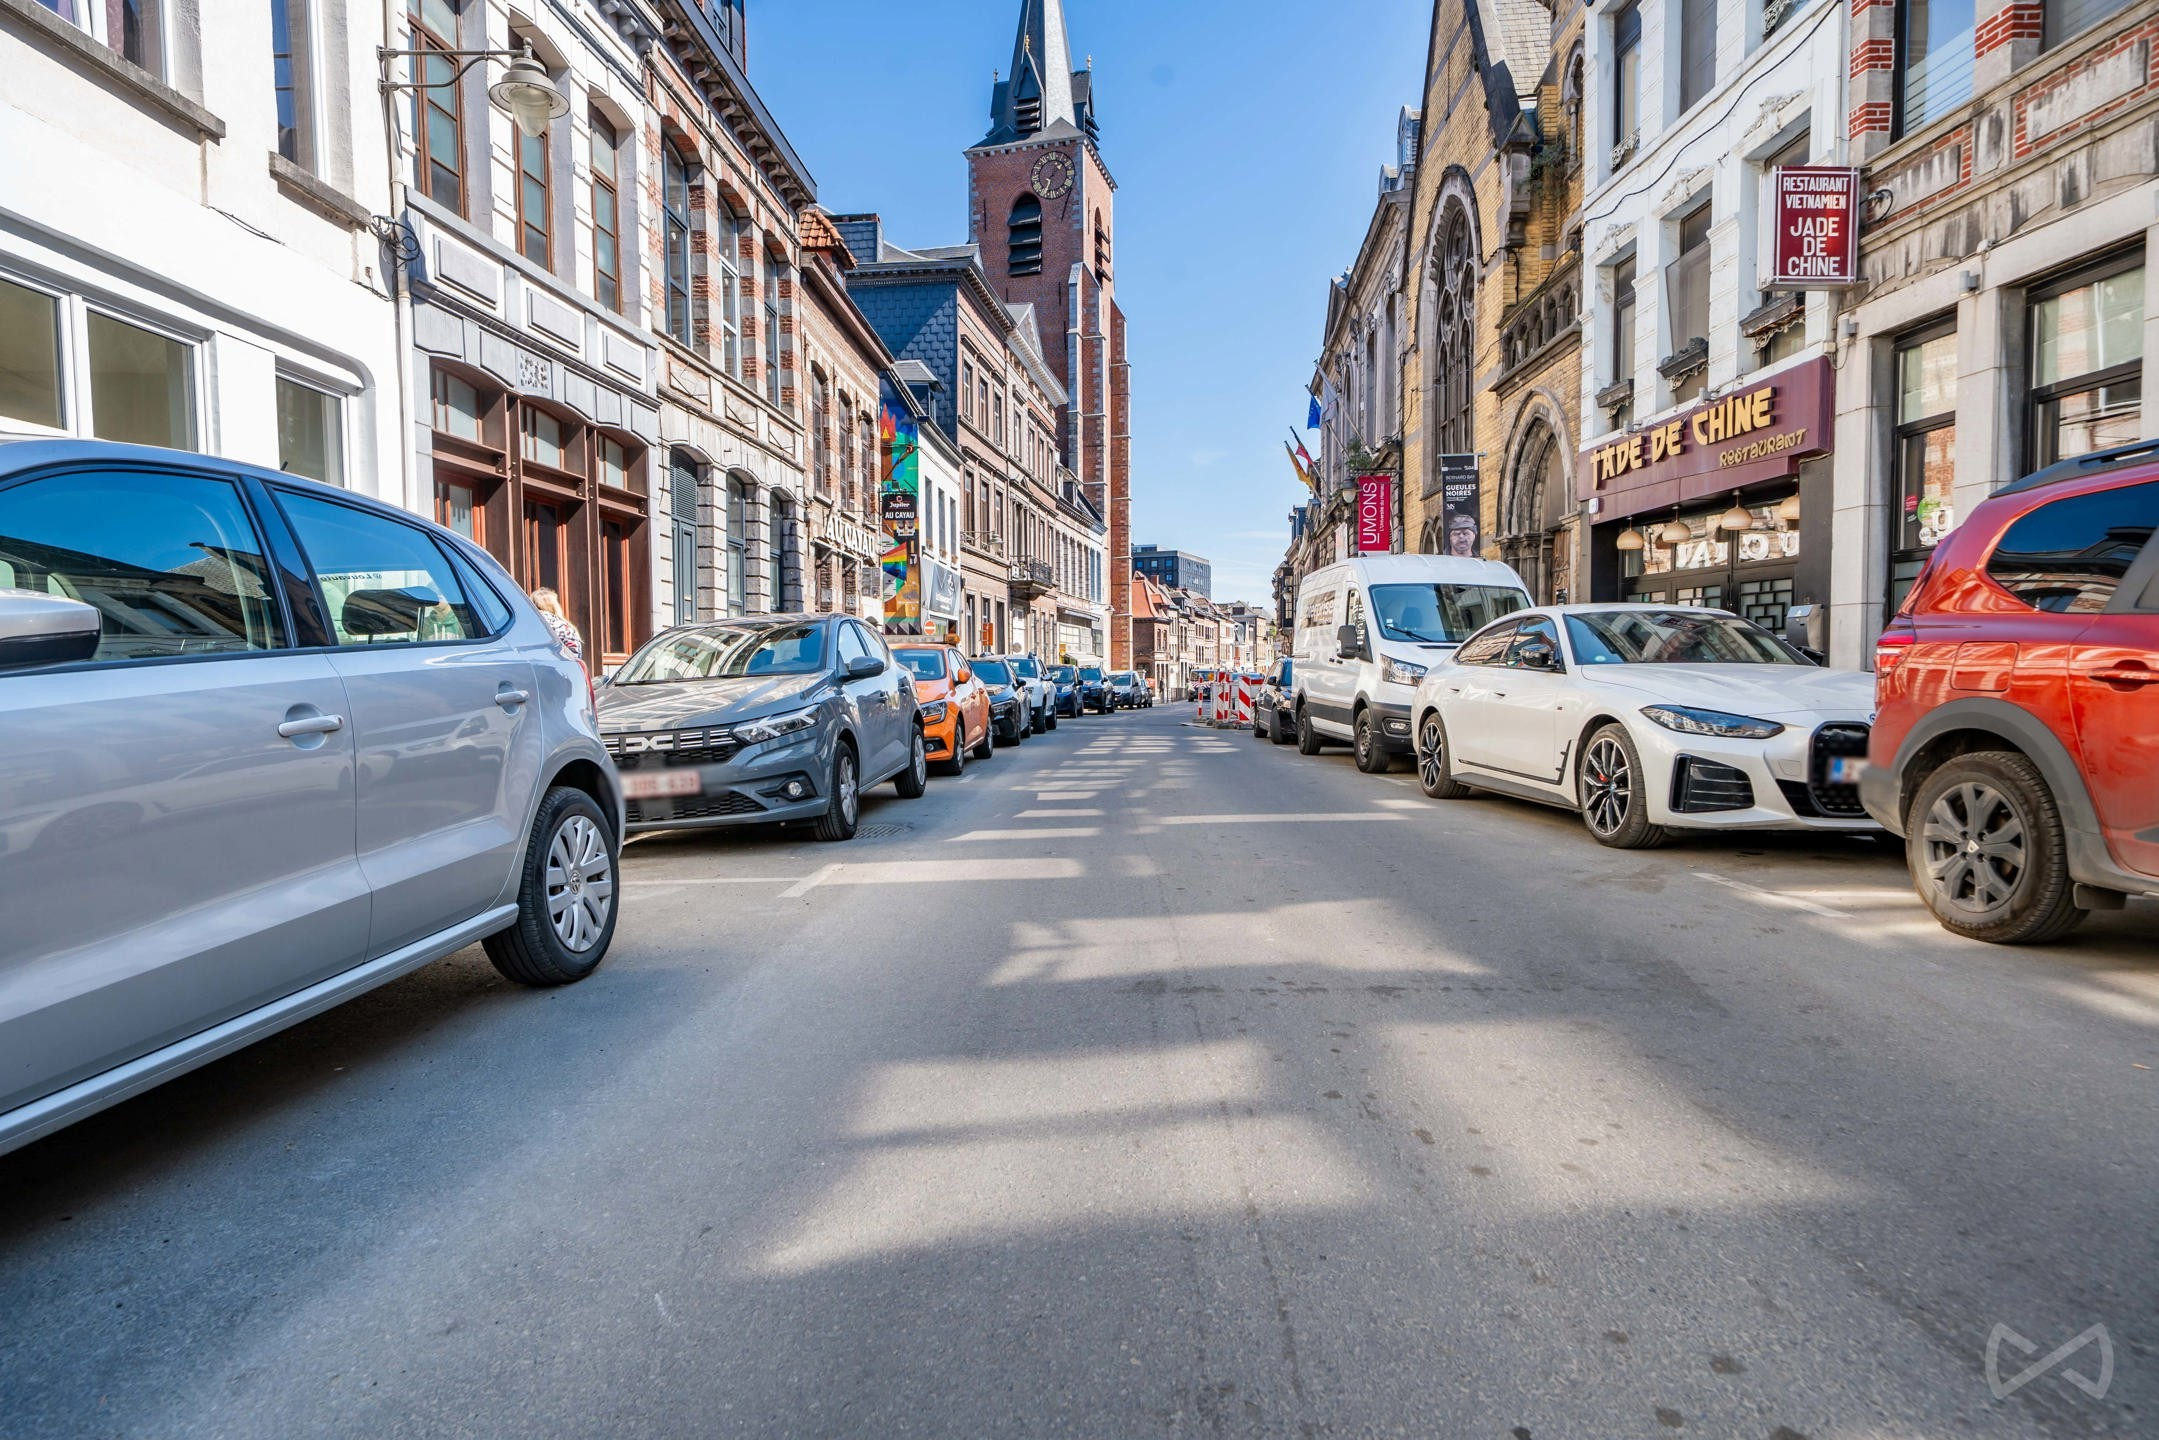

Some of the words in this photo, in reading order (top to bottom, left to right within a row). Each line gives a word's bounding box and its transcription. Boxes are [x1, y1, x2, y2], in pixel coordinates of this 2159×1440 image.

[1783, 177, 1849, 192] RESTAURANT
[1785, 194, 1846, 209] VIETNAMIEN
[1790, 217, 1840, 237] JADE
[1803, 237, 1827, 256] DE
[1787, 256, 1840, 276] CHINE
[1590, 435, 1644, 490] JADE
[1650, 420, 1684, 463] DE
[1692, 387, 1774, 446] CHINE
[1362, 482, 1379, 544] UMONS
[826, 516, 842, 543] AU
[844, 525, 875, 556] CAYAU
